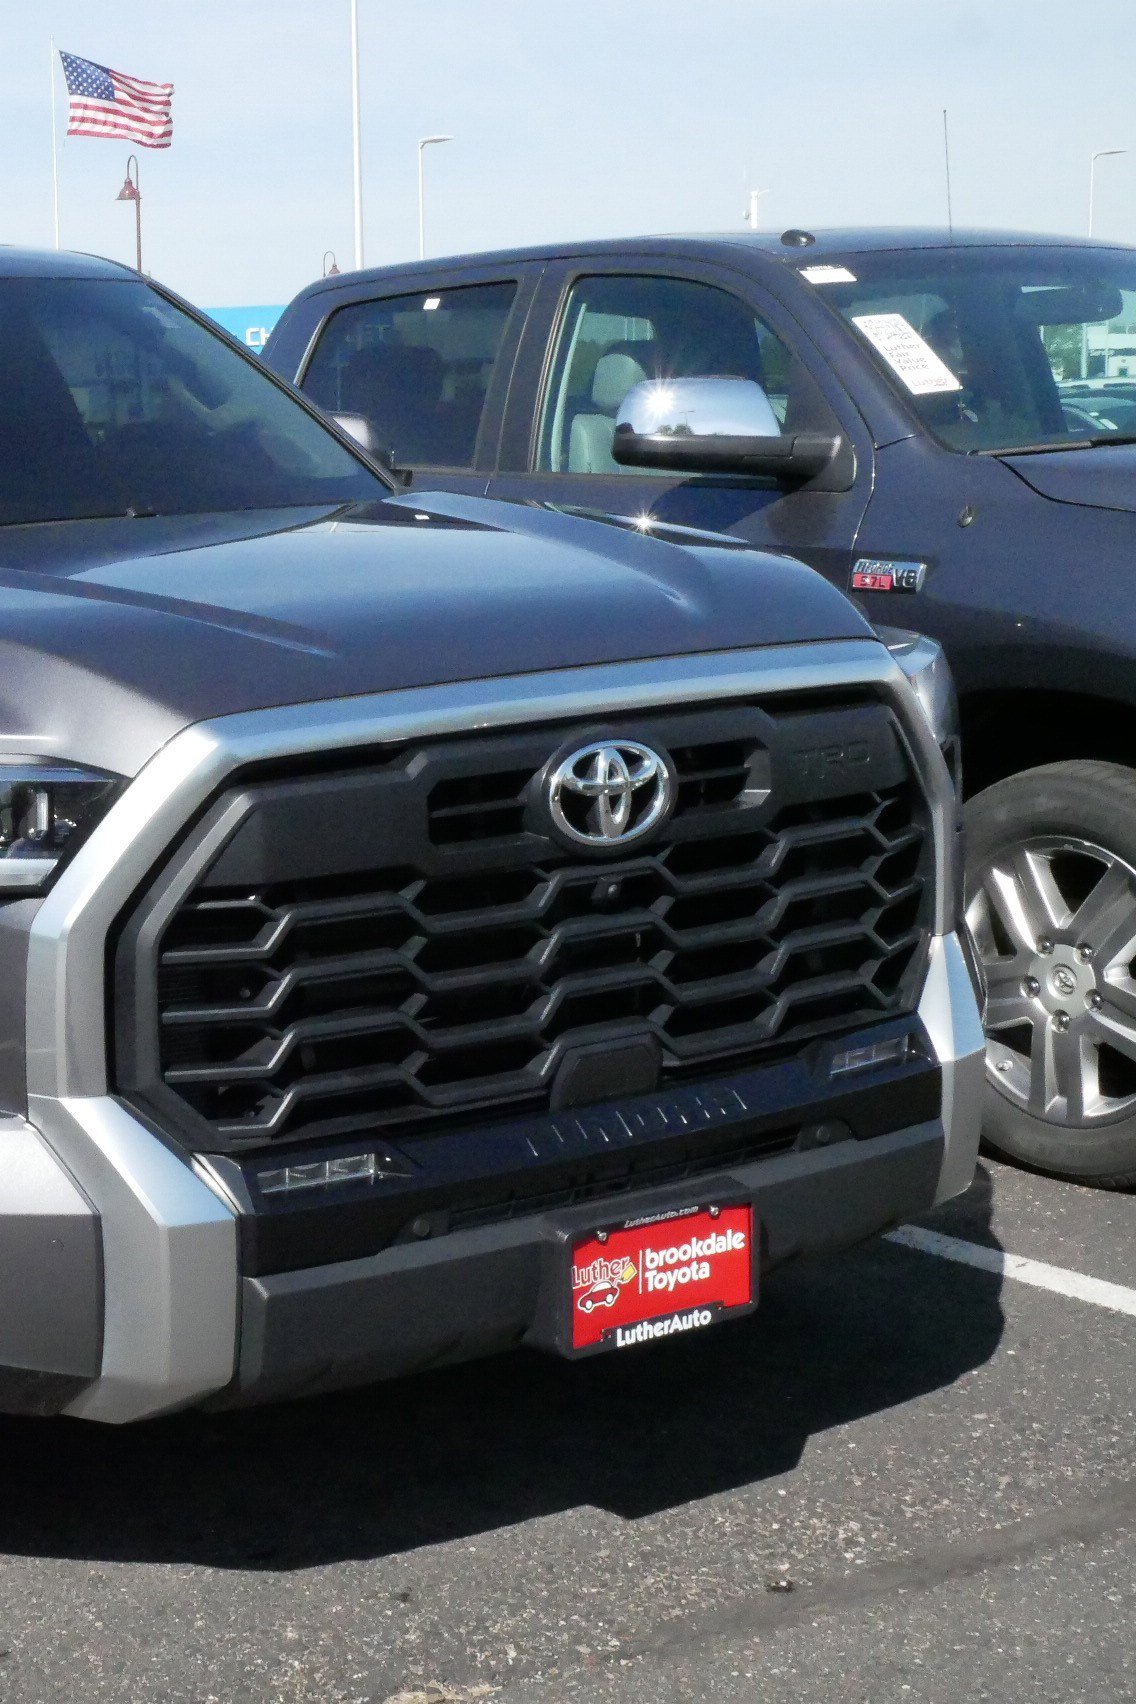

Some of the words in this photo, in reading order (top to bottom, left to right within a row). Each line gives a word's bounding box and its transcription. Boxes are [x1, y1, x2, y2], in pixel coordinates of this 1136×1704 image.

[624, 1206, 699, 1228] LutherAuto.com
[645, 1229, 745, 1269] brookdale
[571, 1256, 631, 1290] Luther
[644, 1261, 710, 1292] Toyota
[616, 1310, 712, 1347] LutherAuto
